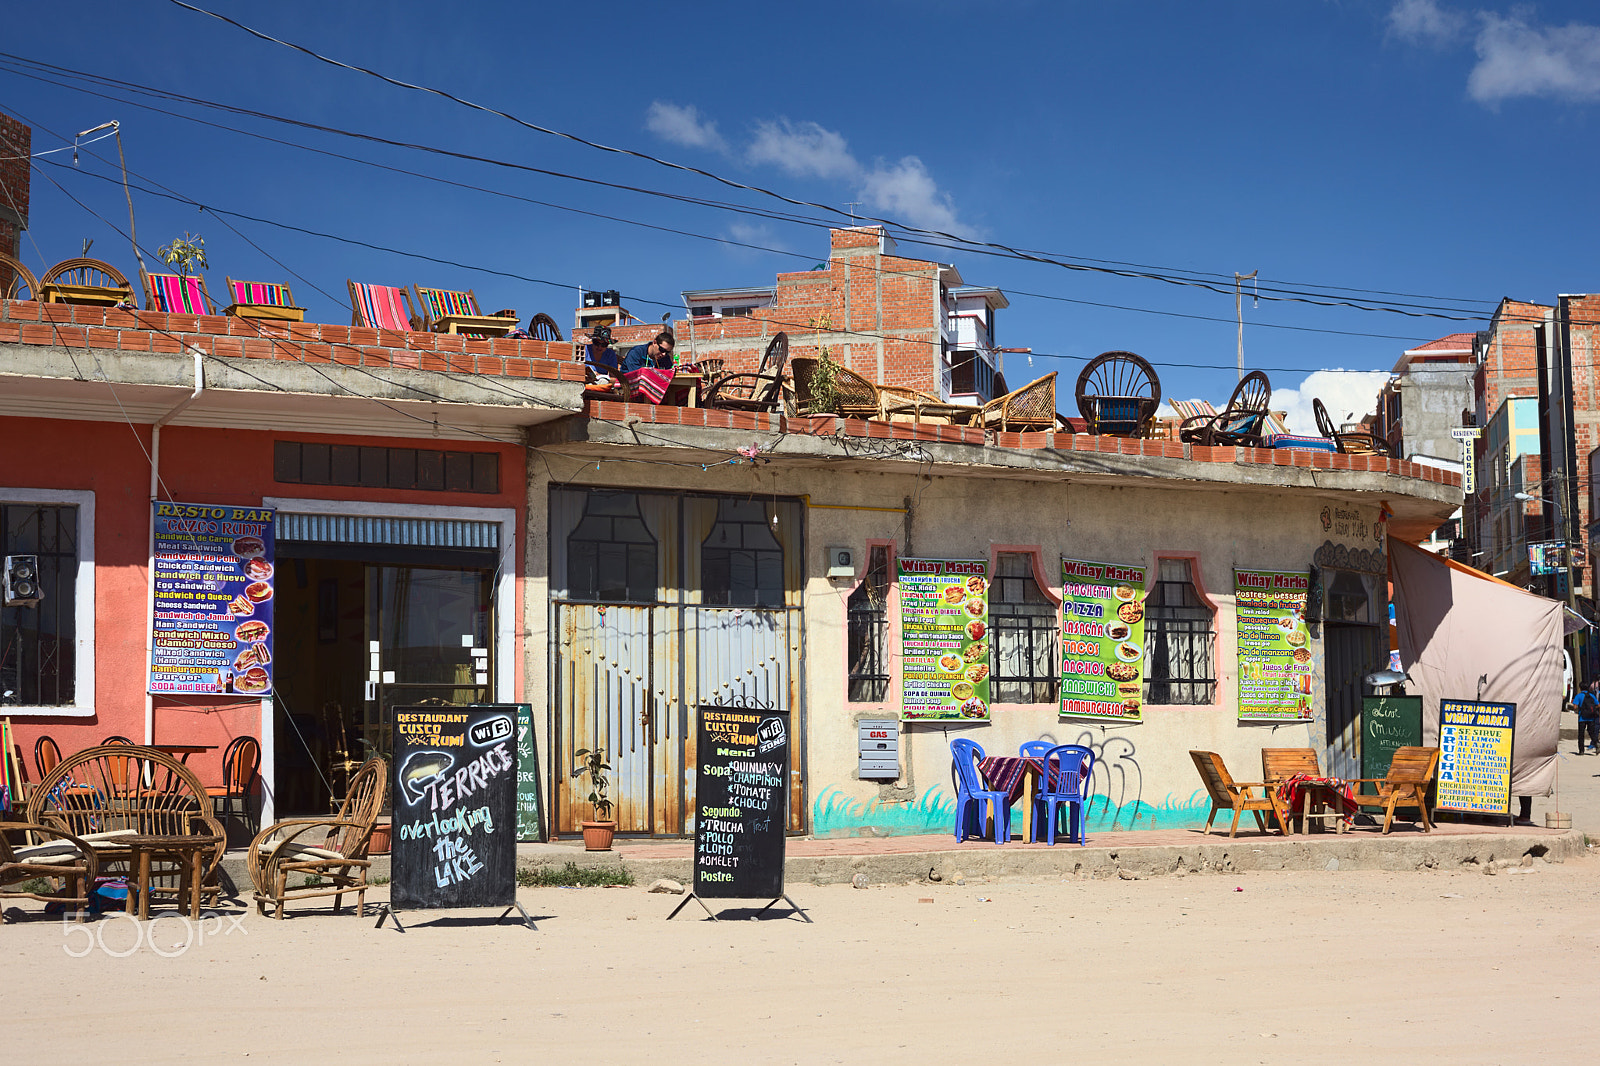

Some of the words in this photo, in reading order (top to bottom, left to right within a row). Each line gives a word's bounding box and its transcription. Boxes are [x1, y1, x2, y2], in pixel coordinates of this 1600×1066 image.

[157, 504, 225, 519] RESTO
[231, 510, 272, 522] BAR
[155, 533, 195, 541] Sandwich
[208, 535, 234, 543] Carne
[182, 544, 223, 552] Sandwich
[155, 552, 201, 561] Sandwich
[158, 562, 191, 570] Chicken
[194, 563, 234, 572] Sandwich
[900, 560, 942, 574] Wiñay
[945, 562, 985, 574] Marka
[1064, 561, 1103, 580] Wiñay
[1105, 566, 1143, 582] Marka
[155, 571, 201, 579] Sandwich
[203, 573, 215, 581] de
[217, 574, 245, 582] Huevo
[1237, 572, 1272, 590] Wiñay
[1274, 574, 1308, 589] Marka
[175, 582, 216, 590] Sandwich
[1064, 582, 1112, 599] SPAGHETTI
[155, 591, 194, 600] Sandwich
[195, 592, 206, 600] de
[1236, 590, 1267, 598] Postres
[1064, 601, 1103, 617] PIZZA
[154, 611, 194, 620] Sandwich
[196, 612, 205, 620] de
[153, 631, 200, 639] Sandwich
[201, 632, 229, 640] Mixto
[1237, 631, 1249, 639] Pie
[1063, 640, 1100, 656] TACOS
[184, 650, 225, 658] Sandwich
[178, 657, 195, 665] and
[152, 665, 218, 674] Hamburguesa
[1063, 659, 1104, 675] NACHOS
[177, 683, 194, 691] and
[1063, 679, 1115, 696] SANDWICHS
[1062, 699, 1124, 716] HAMBURGUESAS
[1445, 704, 1505, 714] RESTAURANT
[398, 714, 468, 723] RESTAURANT
[704, 712, 761, 723] RESTAURANT
[1477, 715, 1509, 727] MARKA
[399, 724, 441, 734] CUSCO
[705, 722, 739, 733] CUSCO
[1473, 729, 1502, 737] SIRVE
[761, 735, 785, 753] ZONE
[1441, 727, 1456, 780] TRUCHA
[424, 742, 513, 811] TERRACE
[734, 784, 771, 799] TOMATE
[735, 796, 767, 810] CHOCLO
[702, 806, 742, 818] Segundo:
[705, 819, 743, 833] TRUCHA
[706, 832, 733, 844] POLLO
[433, 835, 468, 862] the
[706, 844, 733, 855] LOMO
[706, 856, 738, 867] OMELET
[434, 848, 484, 888] LAKE
[701, 871, 734, 881] Postre:
